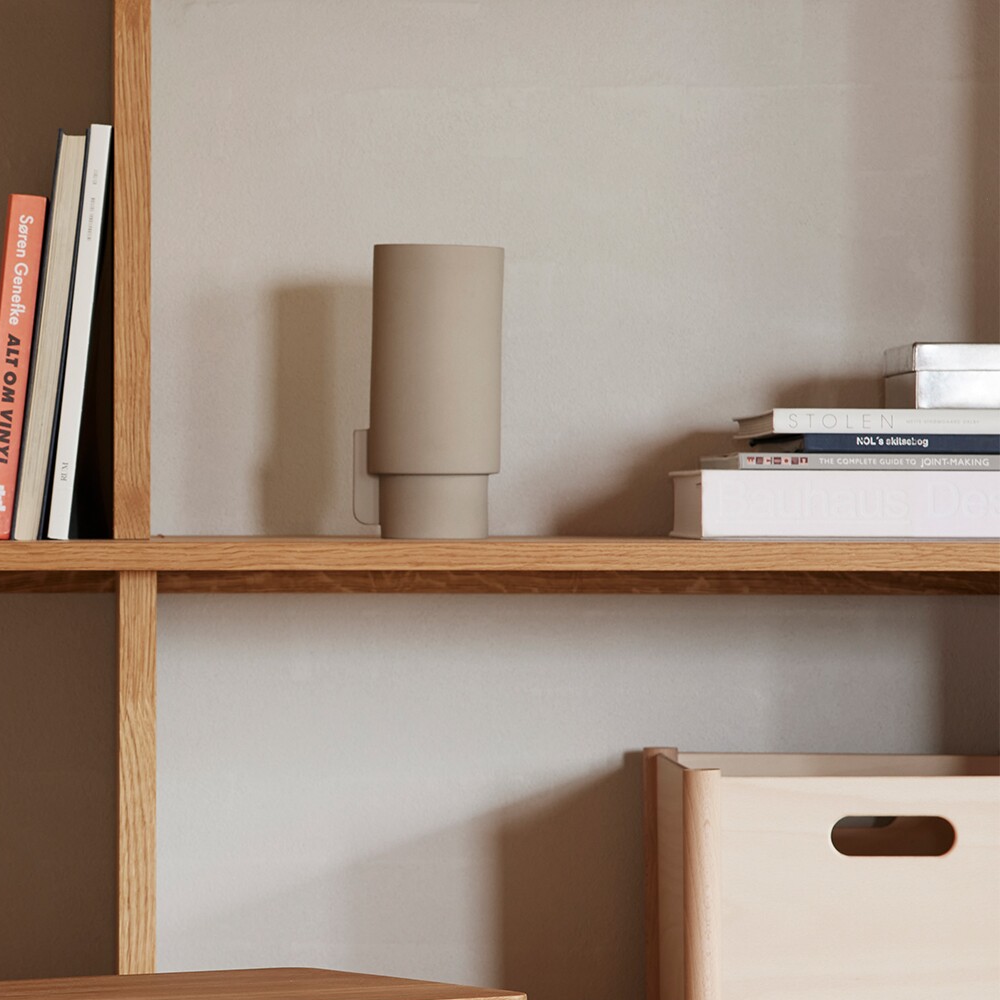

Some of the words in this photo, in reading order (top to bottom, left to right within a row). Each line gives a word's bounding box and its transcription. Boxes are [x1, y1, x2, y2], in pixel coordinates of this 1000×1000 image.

[16, 215, 34, 258] Søren
[9, 262, 29, 326] Genefke
[6, 334, 20, 367] ALT
[2, 372, 17, 403] OM
[789, 414, 893, 429] STOLEN
[886, 437, 929, 447] skitsebog
[921, 458, 990, 467] JOINT-MAKING
